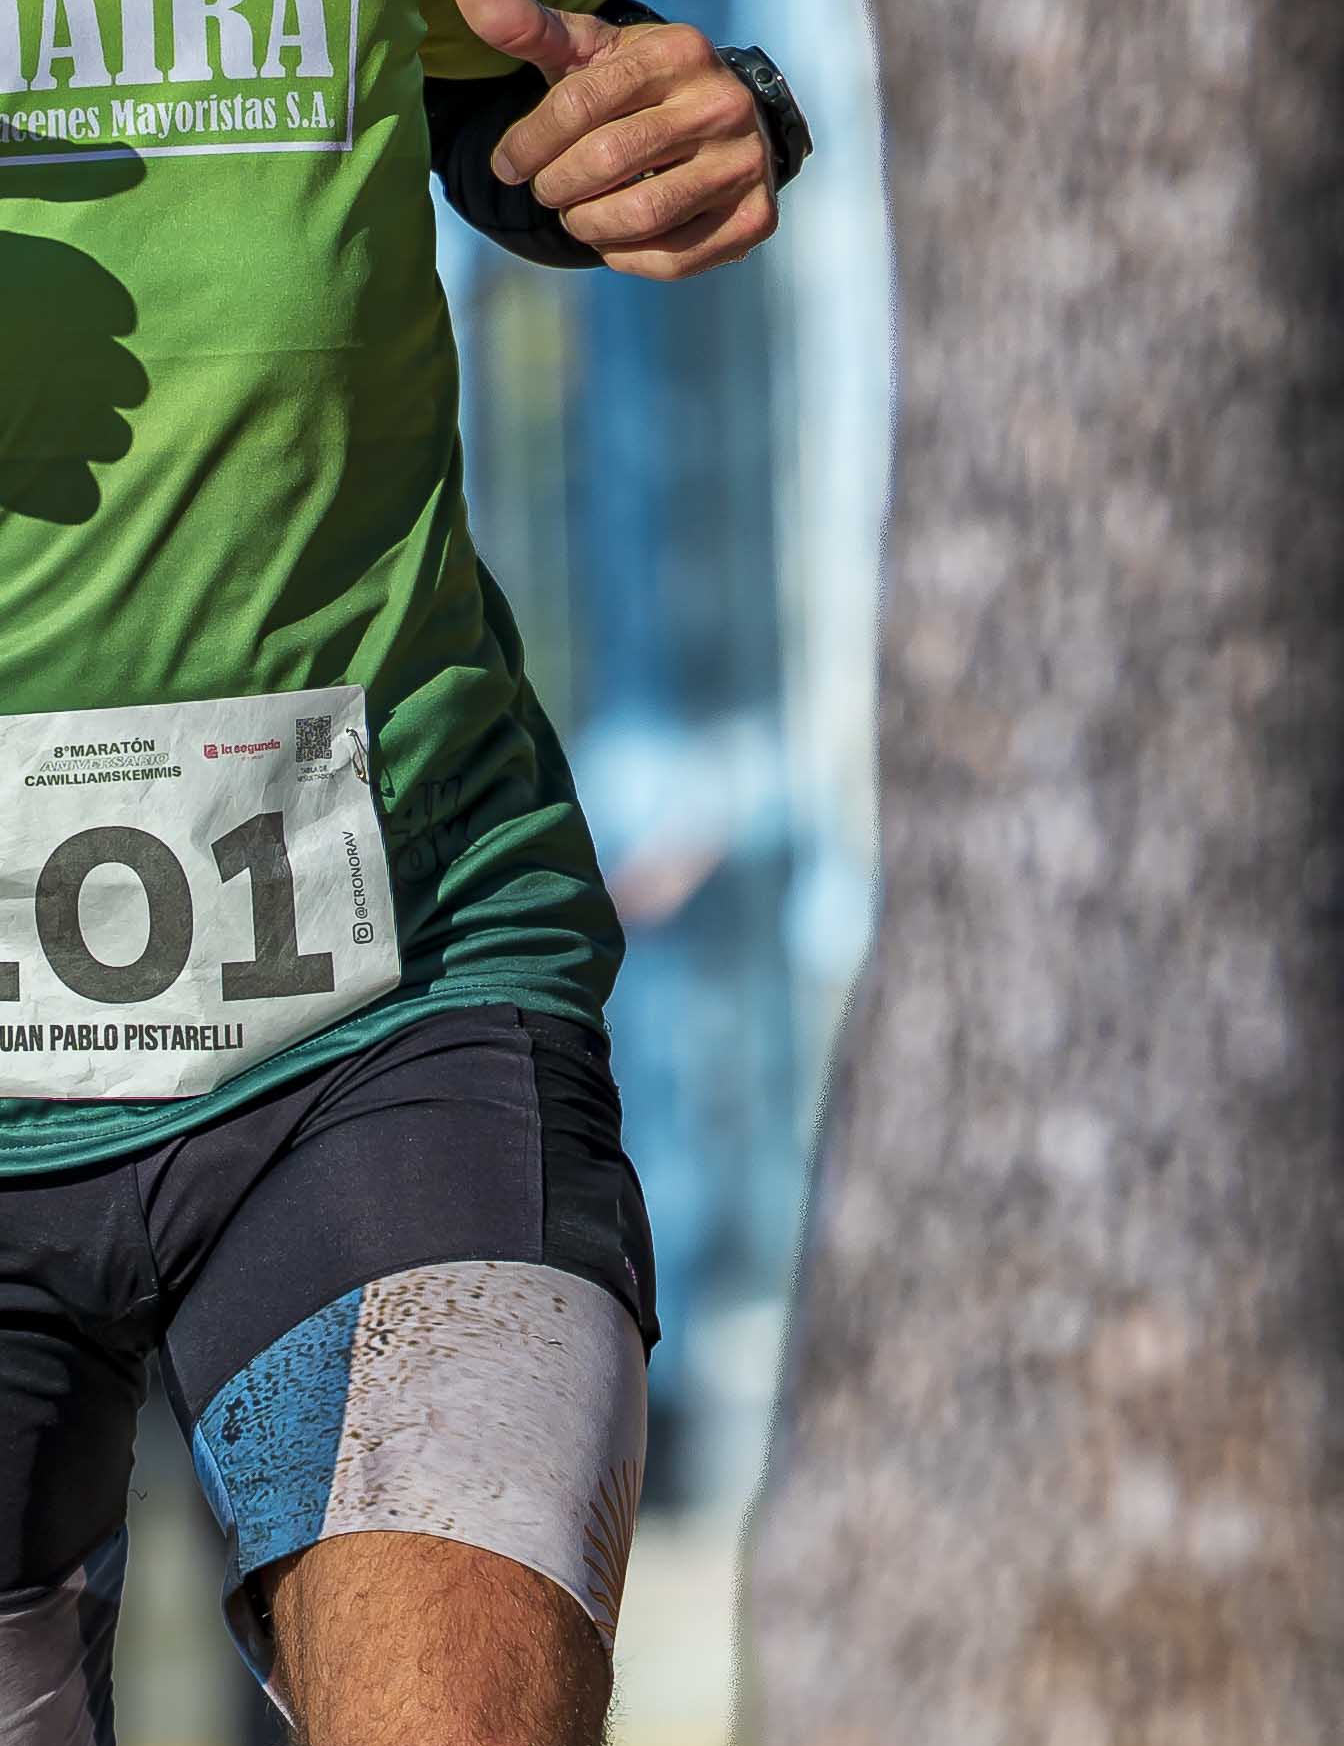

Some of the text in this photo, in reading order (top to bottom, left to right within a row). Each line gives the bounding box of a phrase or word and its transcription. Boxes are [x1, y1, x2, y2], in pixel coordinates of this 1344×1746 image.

[111, 92, 279, 143] Mayoristas
[286, 92, 336, 131] S.A.
[221, 743, 233, 755] la
[40, 752, 169, 773] ANIVERSARIO
[24, 765, 182, 787] CAWILLIAMSKEMMIS
[342, 831, 368, 918] @CRONORAV
[50, 1023, 119, 1052] PABLO
[124, 1022, 244, 1051] PISTARELLI
